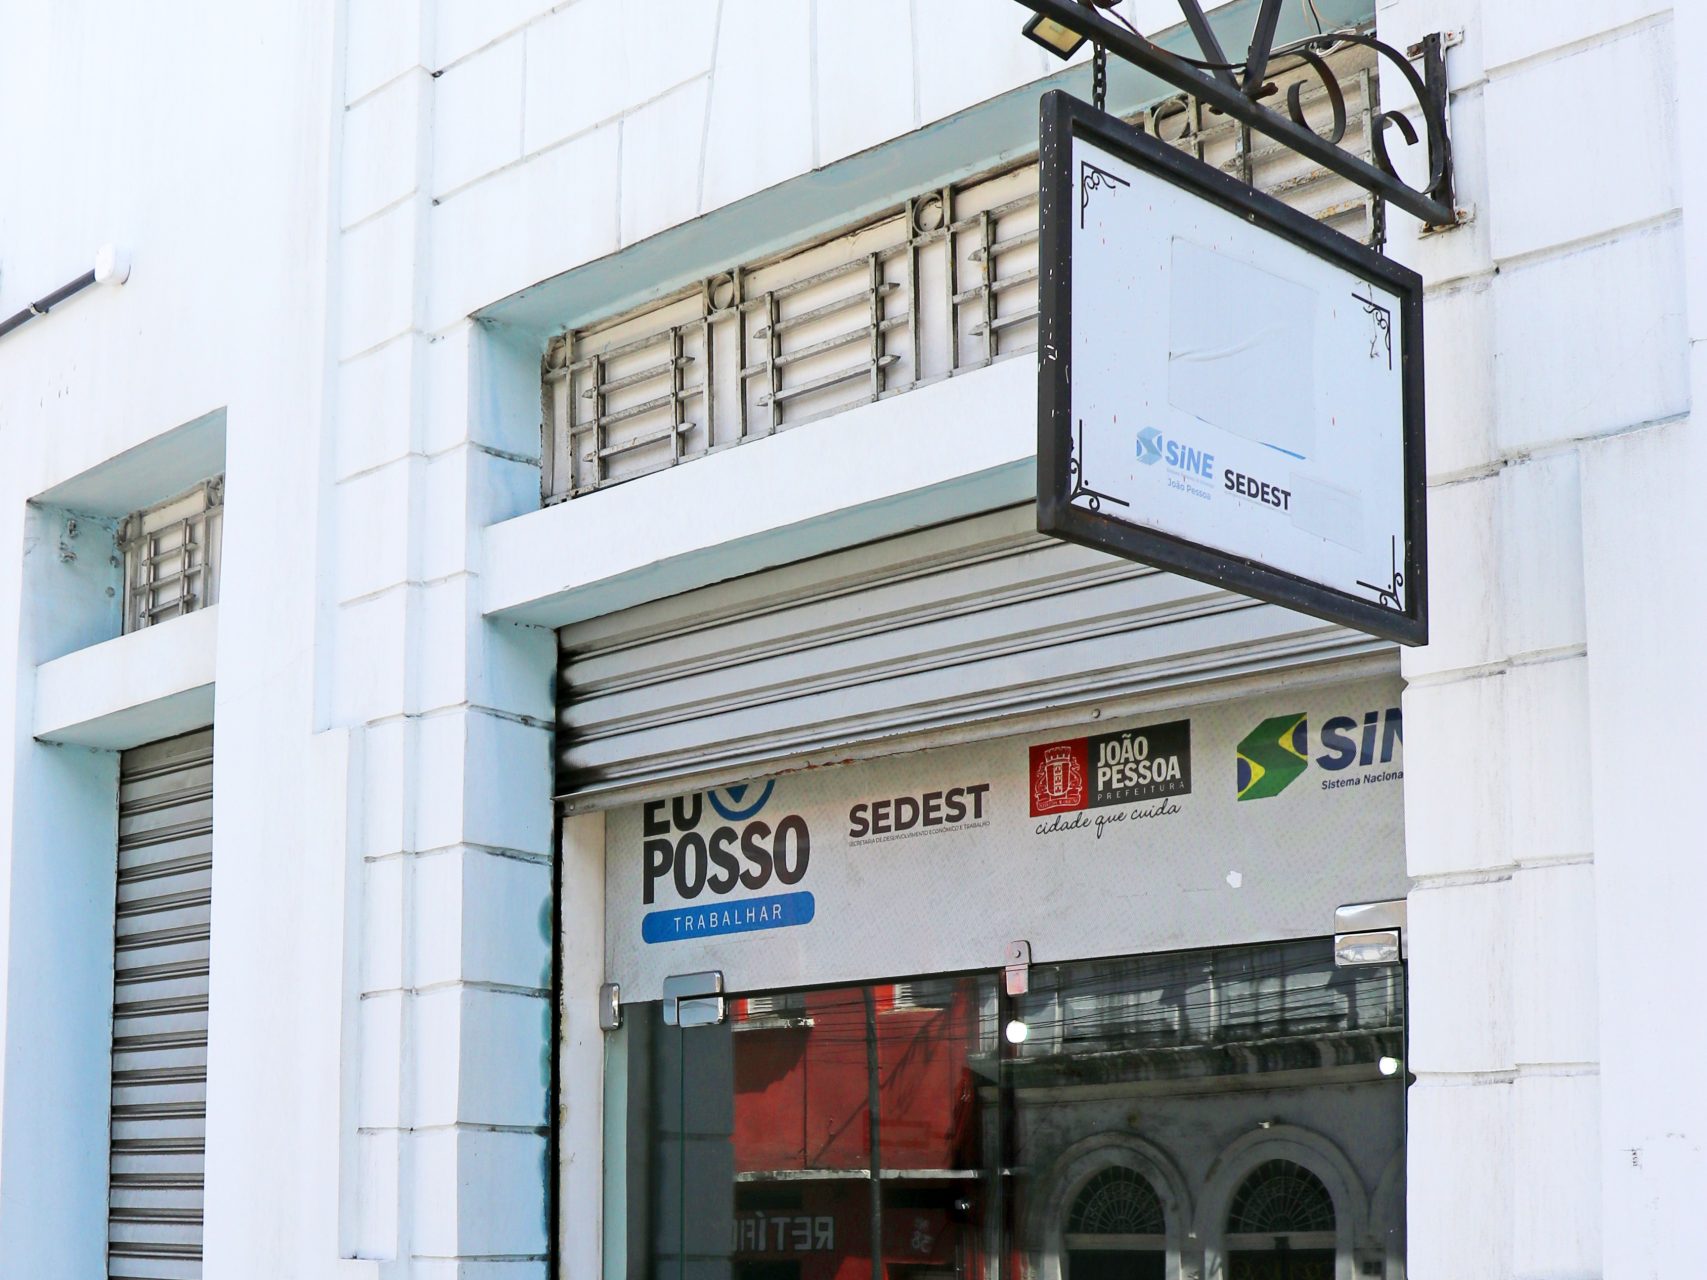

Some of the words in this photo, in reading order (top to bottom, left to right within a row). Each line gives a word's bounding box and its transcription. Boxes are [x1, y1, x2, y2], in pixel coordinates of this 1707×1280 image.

[1224, 468, 1292, 510] SEDEST
[1097, 733, 1148, 767] JOÃO
[1316, 707, 1403, 771] SiN
[1097, 755, 1181, 791] PESSOA
[1097, 781, 1185, 801] PREFEITURA
[1321, 778, 1360, 790] Sistema
[1363, 771, 1404, 784] Naciona
[643, 792, 703, 837] EU
[849, 783, 990, 838] SEDEST
[1035, 812, 1093, 835] cidade
[1094, 813, 1128, 839] que
[1130, 798, 1182, 820] cuida
[643, 814, 810, 904] POSSO
[673, 904, 782, 932] TRABALHAR
